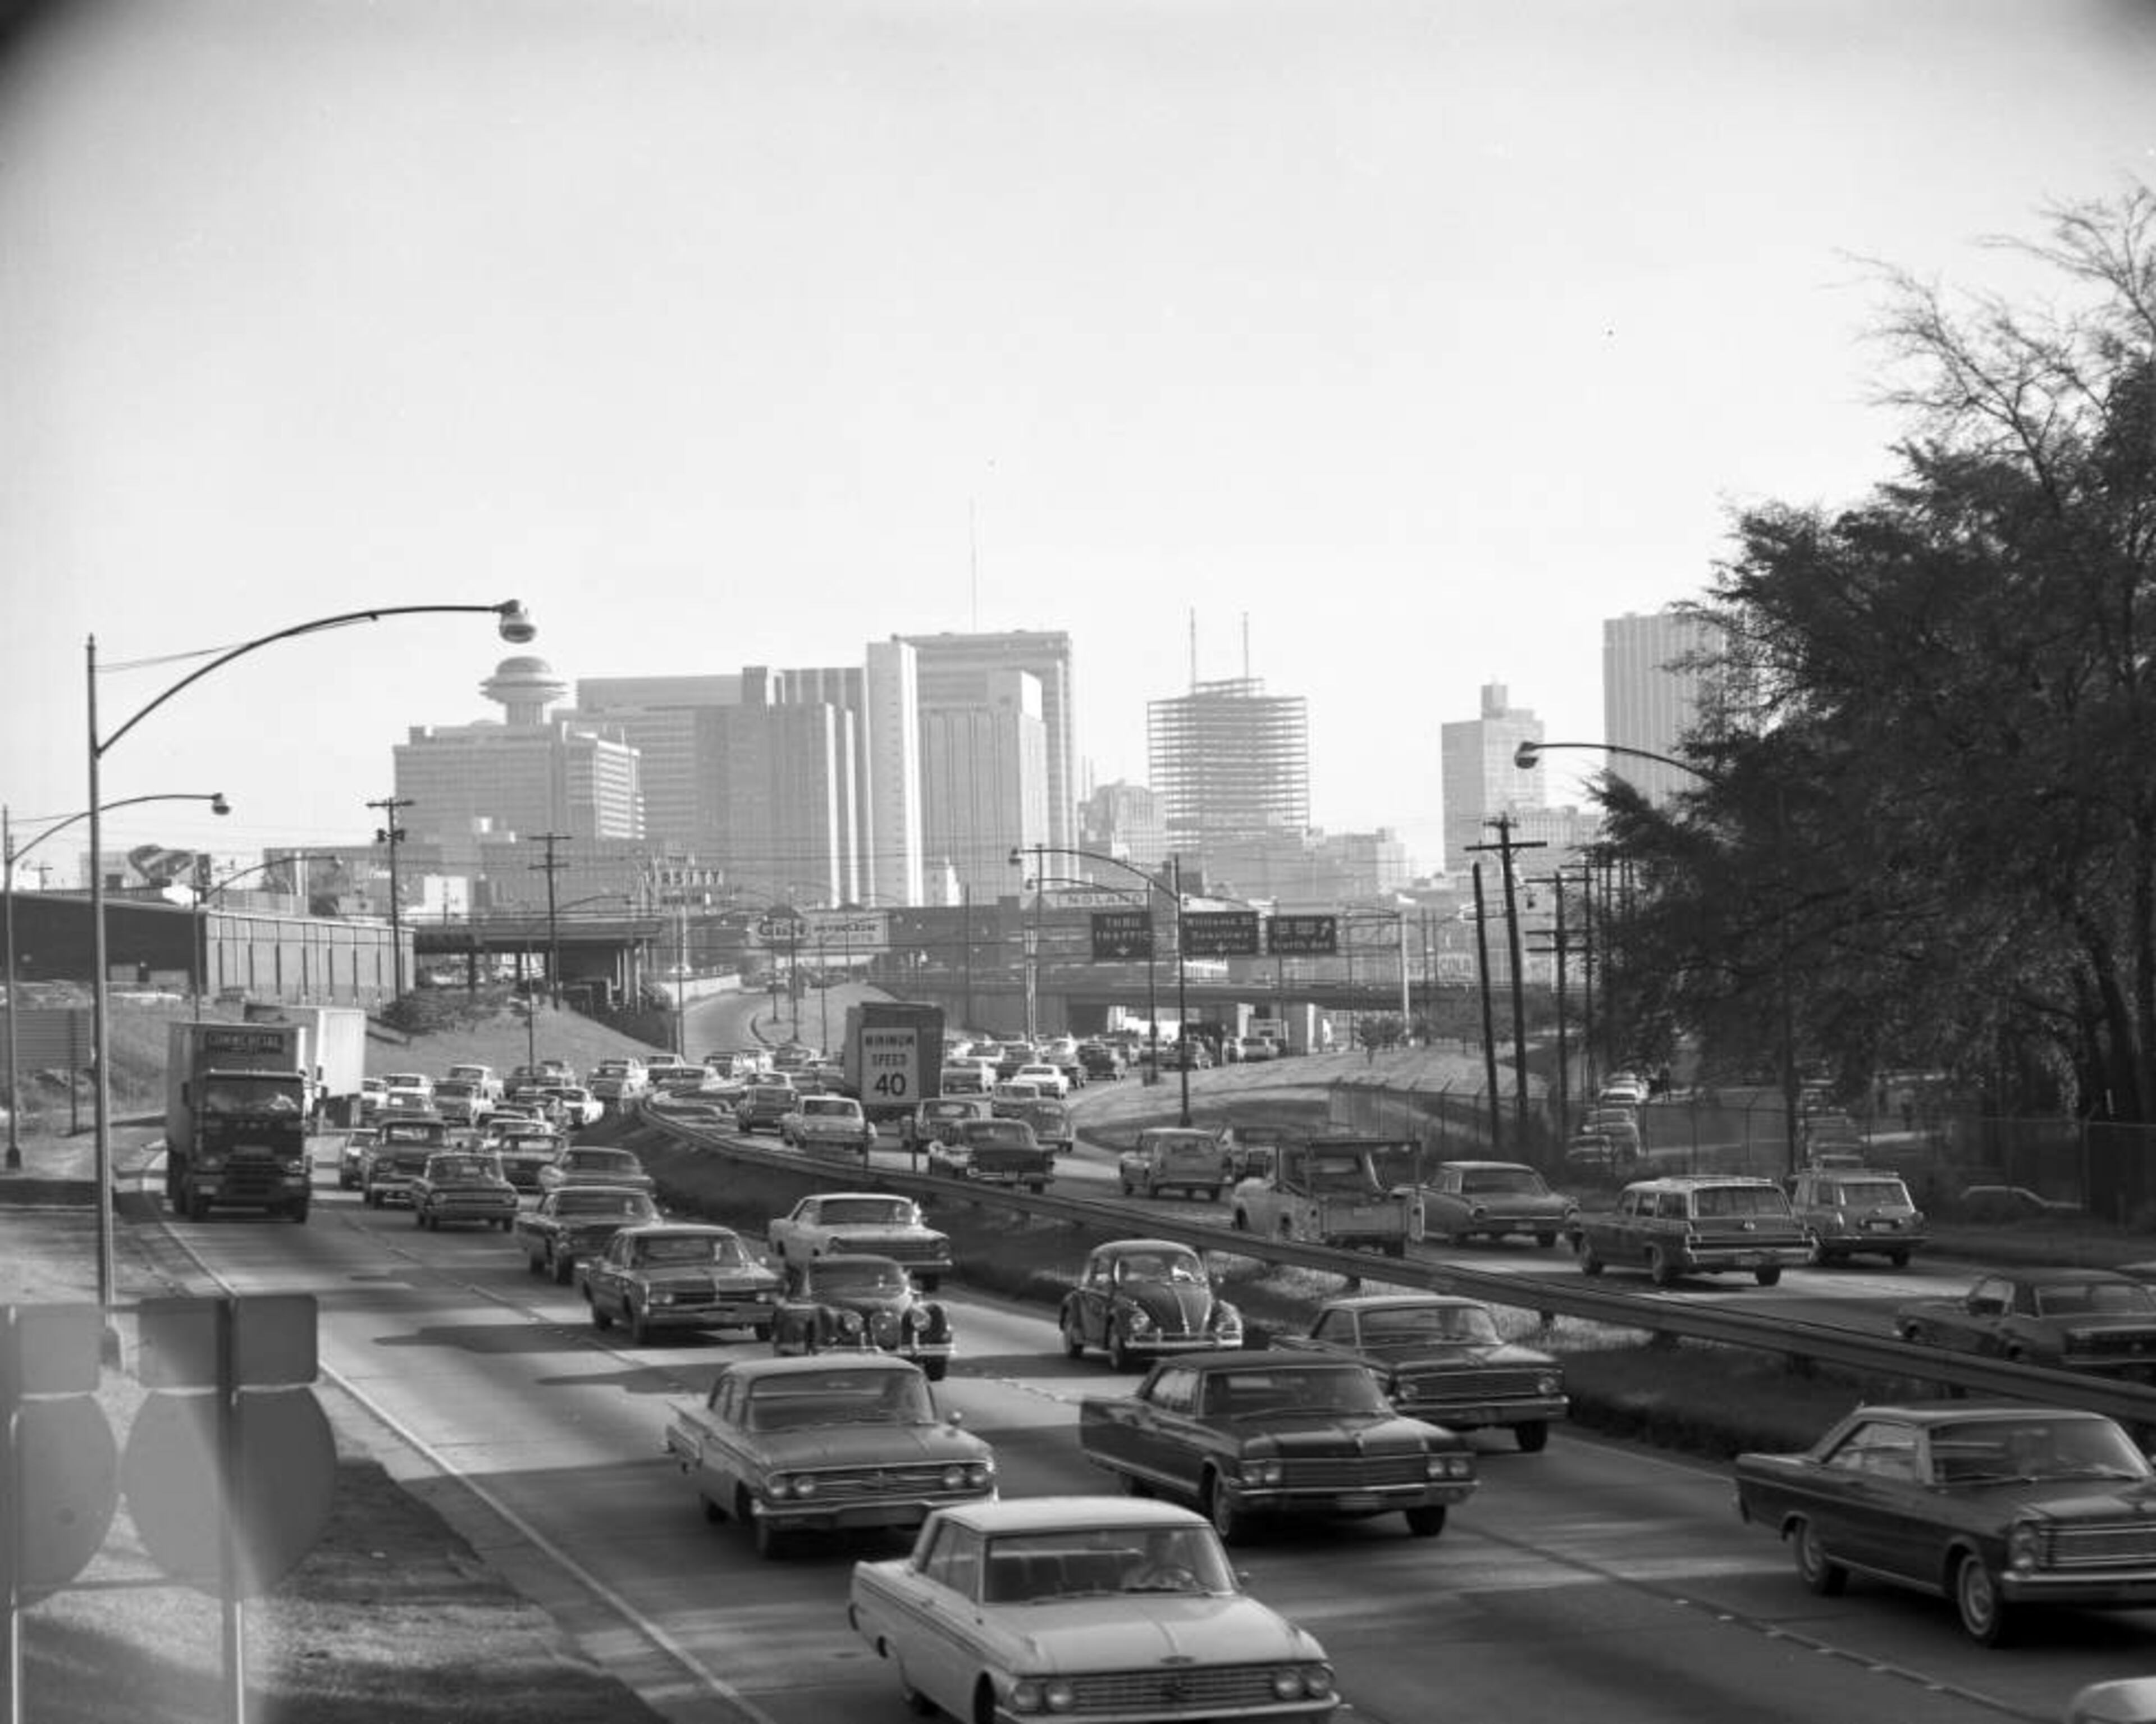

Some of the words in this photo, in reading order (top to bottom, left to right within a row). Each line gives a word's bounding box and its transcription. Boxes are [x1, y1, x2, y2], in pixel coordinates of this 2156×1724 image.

[1106, 918, 1140, 928] THRU
[1095, 931, 1152, 941] TRAFFIC
[865, 1036, 915, 1047] MINIMUM
[871, 1053, 906, 1066] SPEED
[874, 1073, 906, 1097] 40
